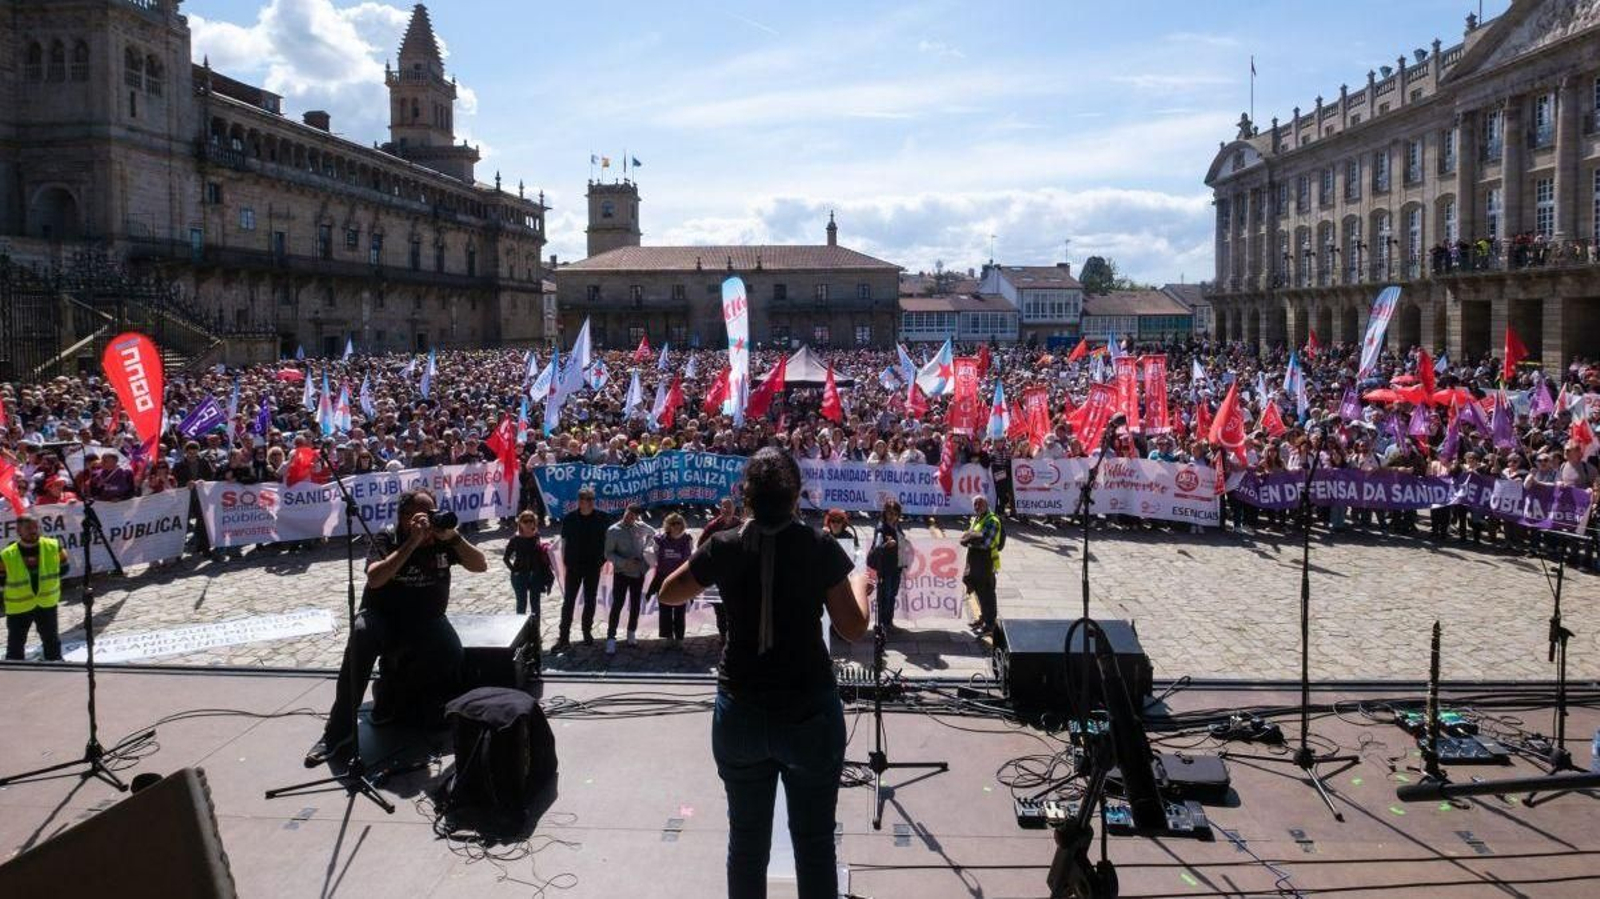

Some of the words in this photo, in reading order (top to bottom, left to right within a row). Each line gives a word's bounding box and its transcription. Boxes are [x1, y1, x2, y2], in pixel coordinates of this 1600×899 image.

[434, 475, 452, 490] EN
[455, 469, 502, 488] PERIGO
[546, 466, 576, 482] POR
[581, 467, 620, 481] UNHA
[662, 470, 679, 484] EN
[683, 470, 727, 487] GALIZA
[827, 468, 872, 482] SANIDADE
[875, 467, 916, 485] PÚBLICA
[222, 491, 276, 508] SOS
[825, 489, 868, 503] PERSOAL
[899, 491, 951, 507] CALIDADE
[1260, 484, 1281, 504] EN
[1363, 482, 1387, 501] DA
[1016, 500, 1062, 509] ESENCIAIS
[1172, 506, 1219, 521] ESENCIAIS
[110, 516, 183, 543] PÚBLICA
